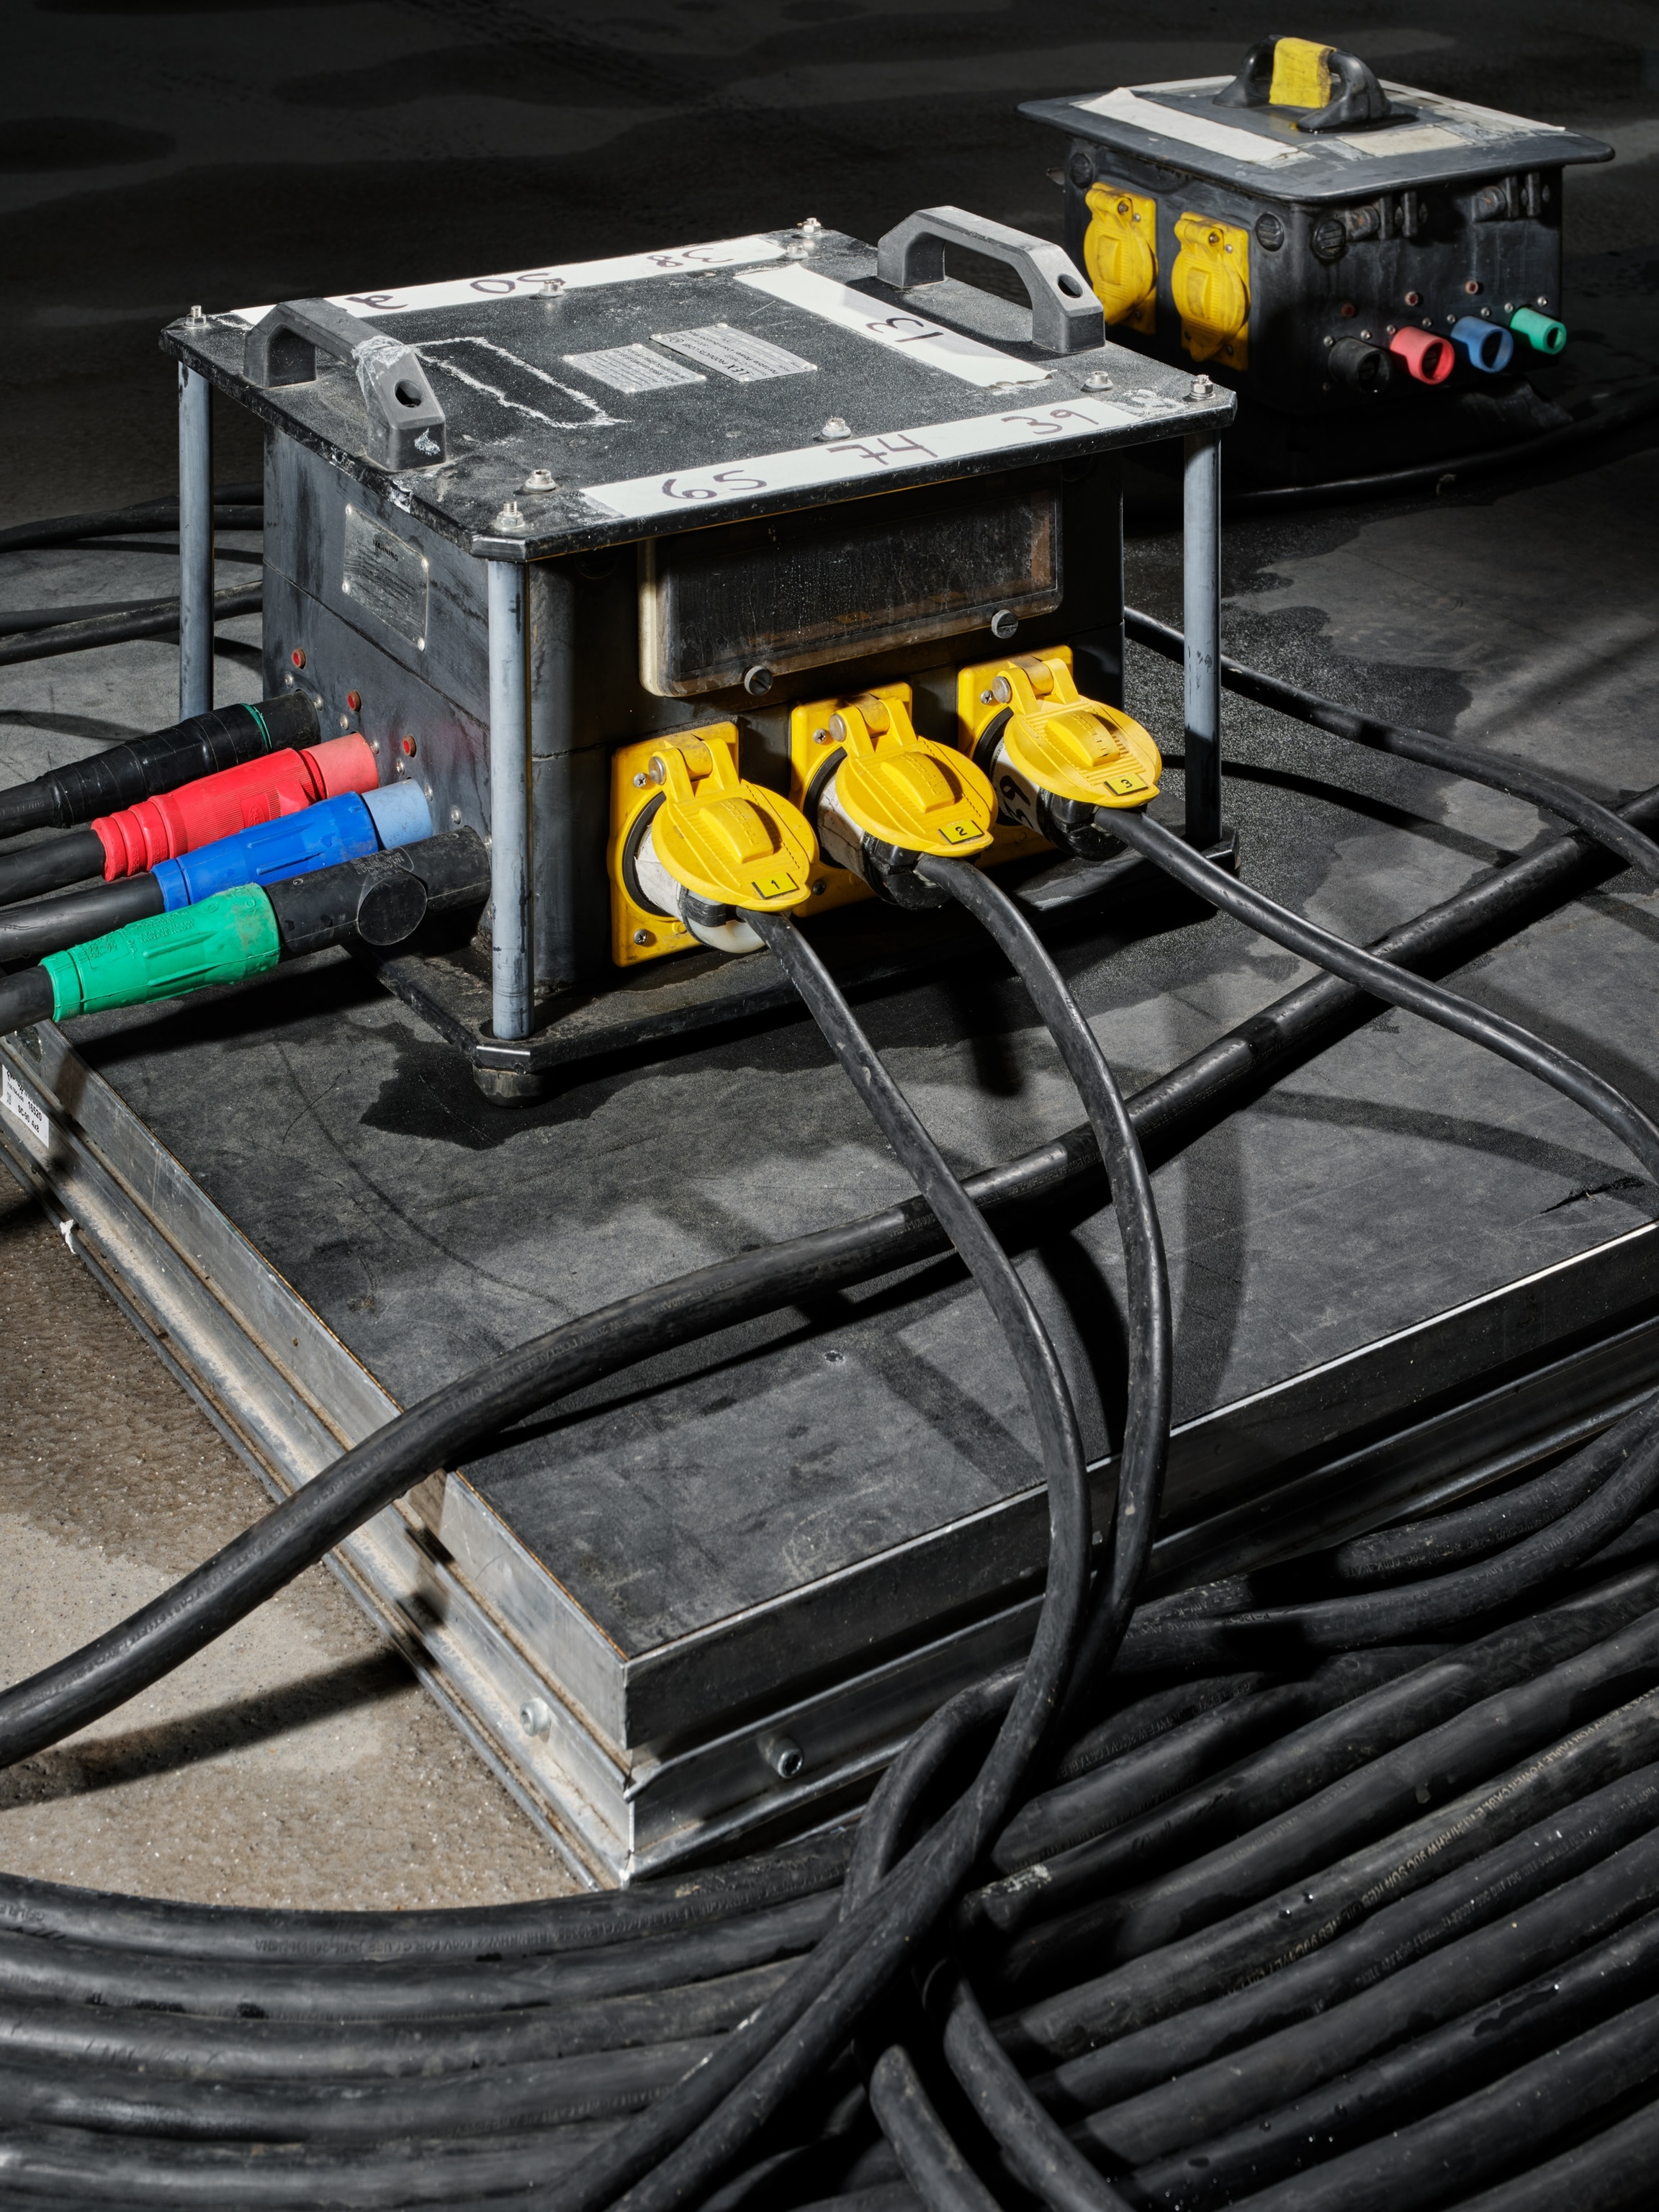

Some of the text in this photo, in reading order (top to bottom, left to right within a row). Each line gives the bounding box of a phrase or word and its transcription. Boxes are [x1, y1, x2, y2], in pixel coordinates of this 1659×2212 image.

[646, 246, 734, 269] 38
[724, 364, 751, 376] LEX
[999, 408, 1100, 435] 39
[826, 433, 939, 466] 74
[662, 469, 768, 500] 65
[372, 539, 398, 562] WARNING
[1120, 779, 1133, 788] 3
[955, 826, 968, 836] 2
[771, 880, 781, 889] 1
[1542, 1726, 1595, 1763] PORTABLE
[1473, 1786, 1511, 1818] CABLE
